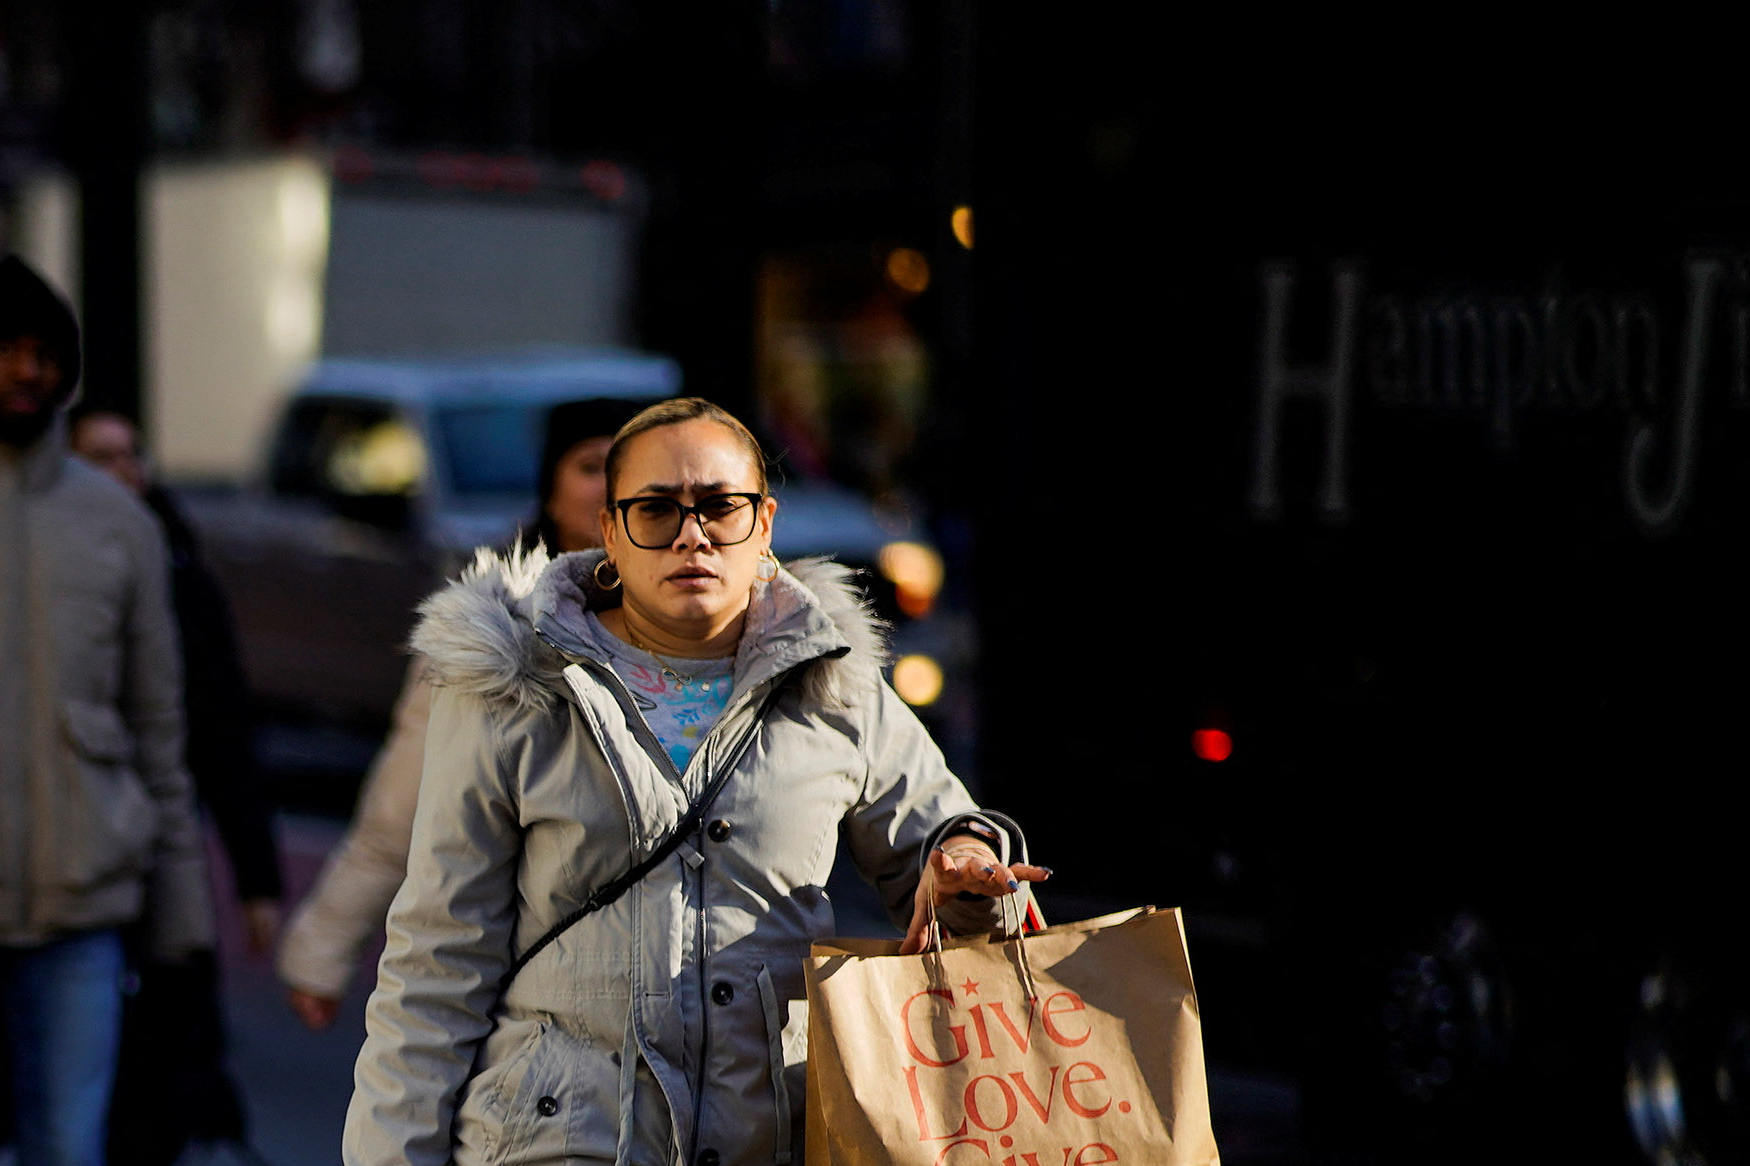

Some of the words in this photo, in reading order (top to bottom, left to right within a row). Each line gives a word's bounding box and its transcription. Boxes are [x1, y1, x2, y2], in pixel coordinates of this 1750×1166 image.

[1249, 254, 1658, 526] Hampton
[899, 977, 1092, 1068] Give
[902, 1060, 1132, 1142] Love.
